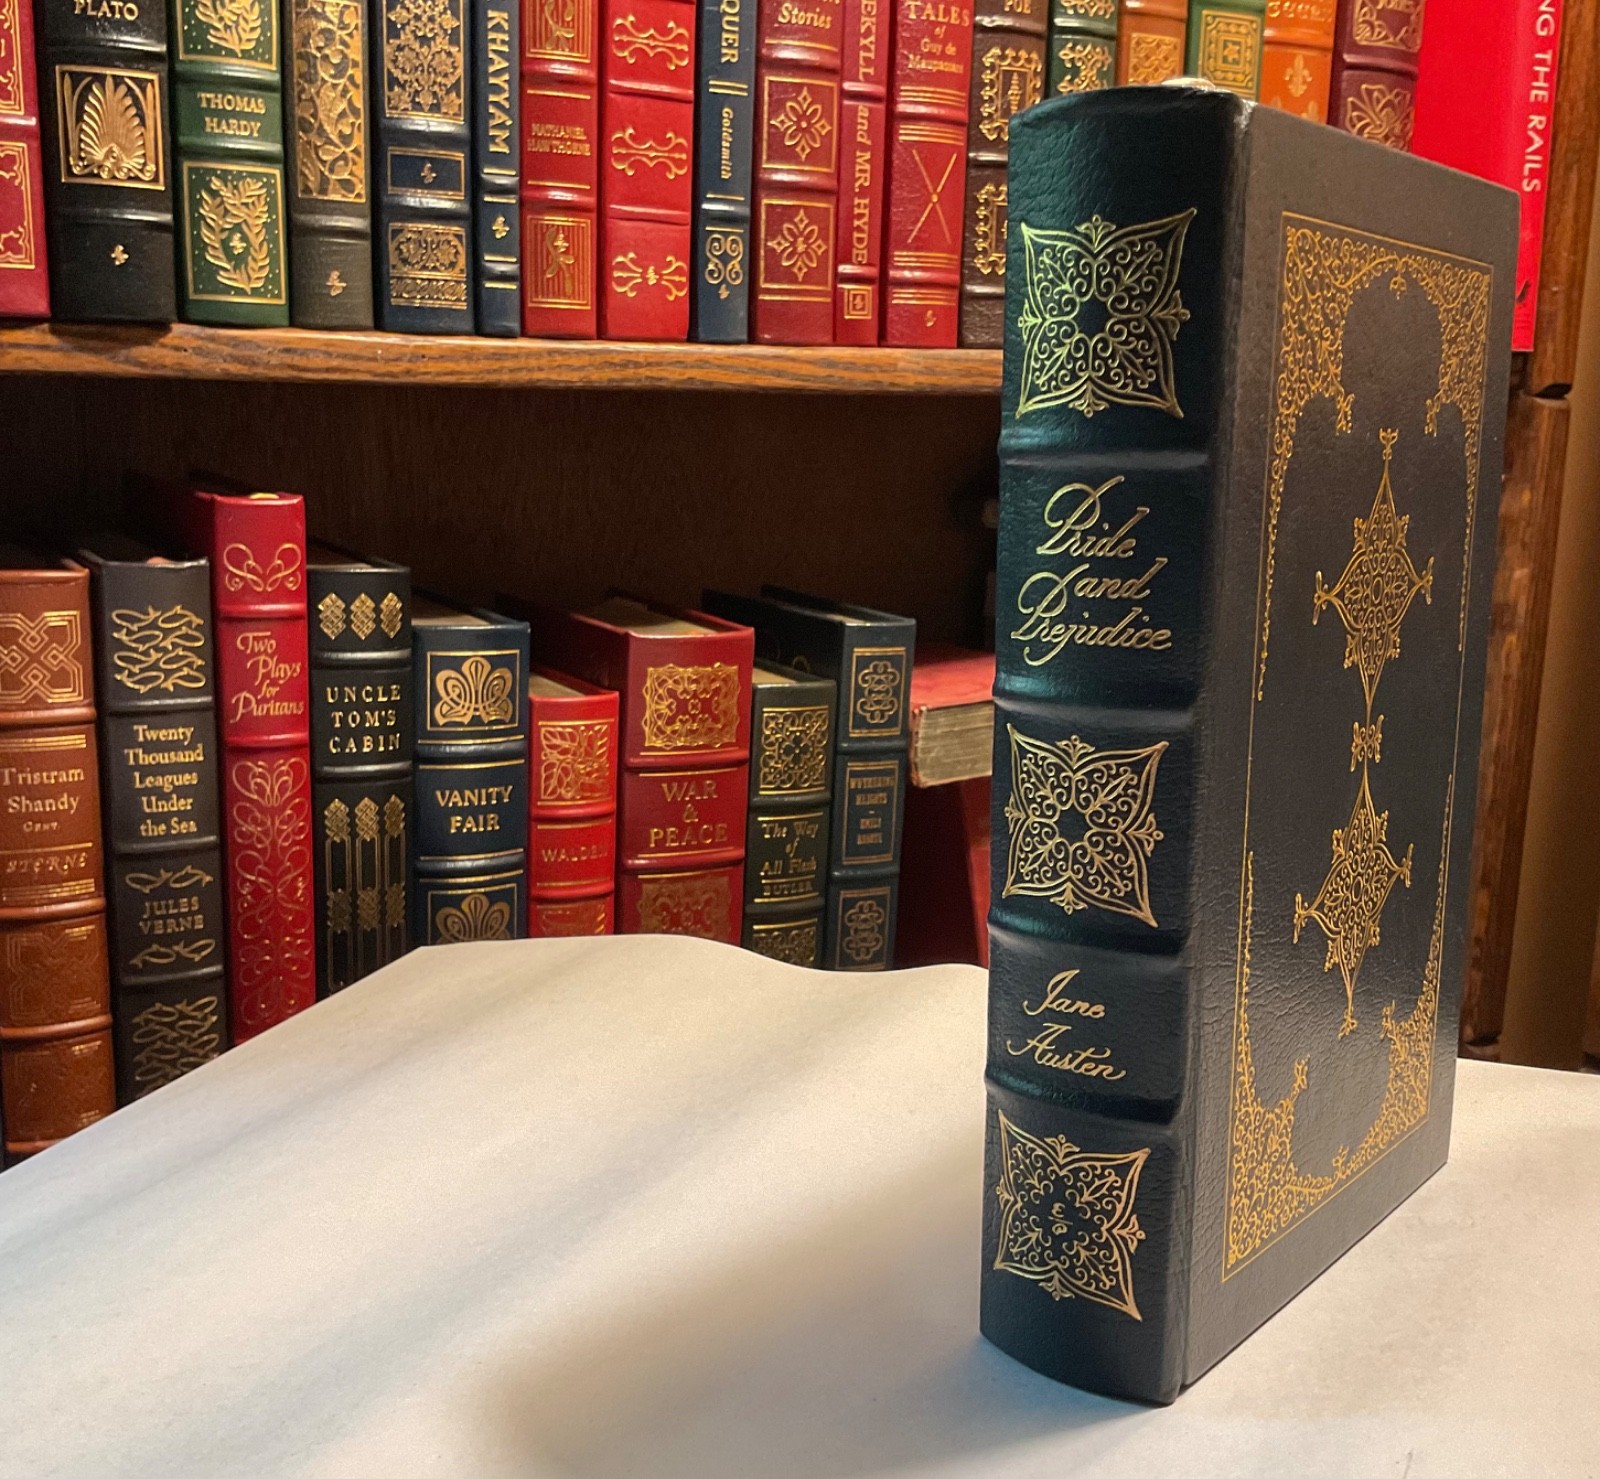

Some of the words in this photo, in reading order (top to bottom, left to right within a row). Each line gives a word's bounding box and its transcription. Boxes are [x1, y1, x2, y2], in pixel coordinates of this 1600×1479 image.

[73, 0, 139, 21] PLATO
[777, 2, 833, 30] Stories
[904, 0, 970, 27] TALES
[934, 25, 947, 39] of
[920, 37, 943, 55] Guy
[1529, 49, 1553, 103] THE
[197, 91, 267, 115] THOMAS
[204, 116, 262, 138] HARDY
[856, 104, 872, 146] and
[720, 107, 734, 180] Goldsmith
[1521, 114, 1547, 192] RAILS
[853, 150, 871, 193] MR.
[851, 196, 869, 264] HYDE
[1035, 475, 1150, 557] Pride
[1073, 557, 1169, 599] and
[1010, 563, 1173, 667] Prejudice
[236, 631, 277, 654] Two
[246, 654, 302, 687] Plays
[257, 679, 280, 700] for
[326, 684, 401, 703] UNCLE
[229, 691, 305, 724] Puritans
[331, 709, 397, 729] TOM'S
[133, 724, 195, 747] Twenty
[329, 732, 401, 755] CABIN
[124, 742, 205, 766] Thousand
[2, 767, 86, 787] Tristram
[133, 771, 199, 793] Leagues
[435, 785, 514, 808] VANITY
[661, 779, 719, 803] WAR
[7, 792, 80, 815] Shandy
[141, 793, 194, 814] Under
[682, 803, 700, 824] &
[140, 819, 167, 837] the
[170, 817, 198, 835] Sea
[450, 813, 501, 834] FAIR
[648, 822, 729, 848] PEACE
[761, 823, 788, 839] The
[142, 895, 200, 919] JULES
[138, 913, 205, 936] VERNE
[1022, 968, 1106, 1019] Jane
[1006, 1022, 1127, 1081] Austen
